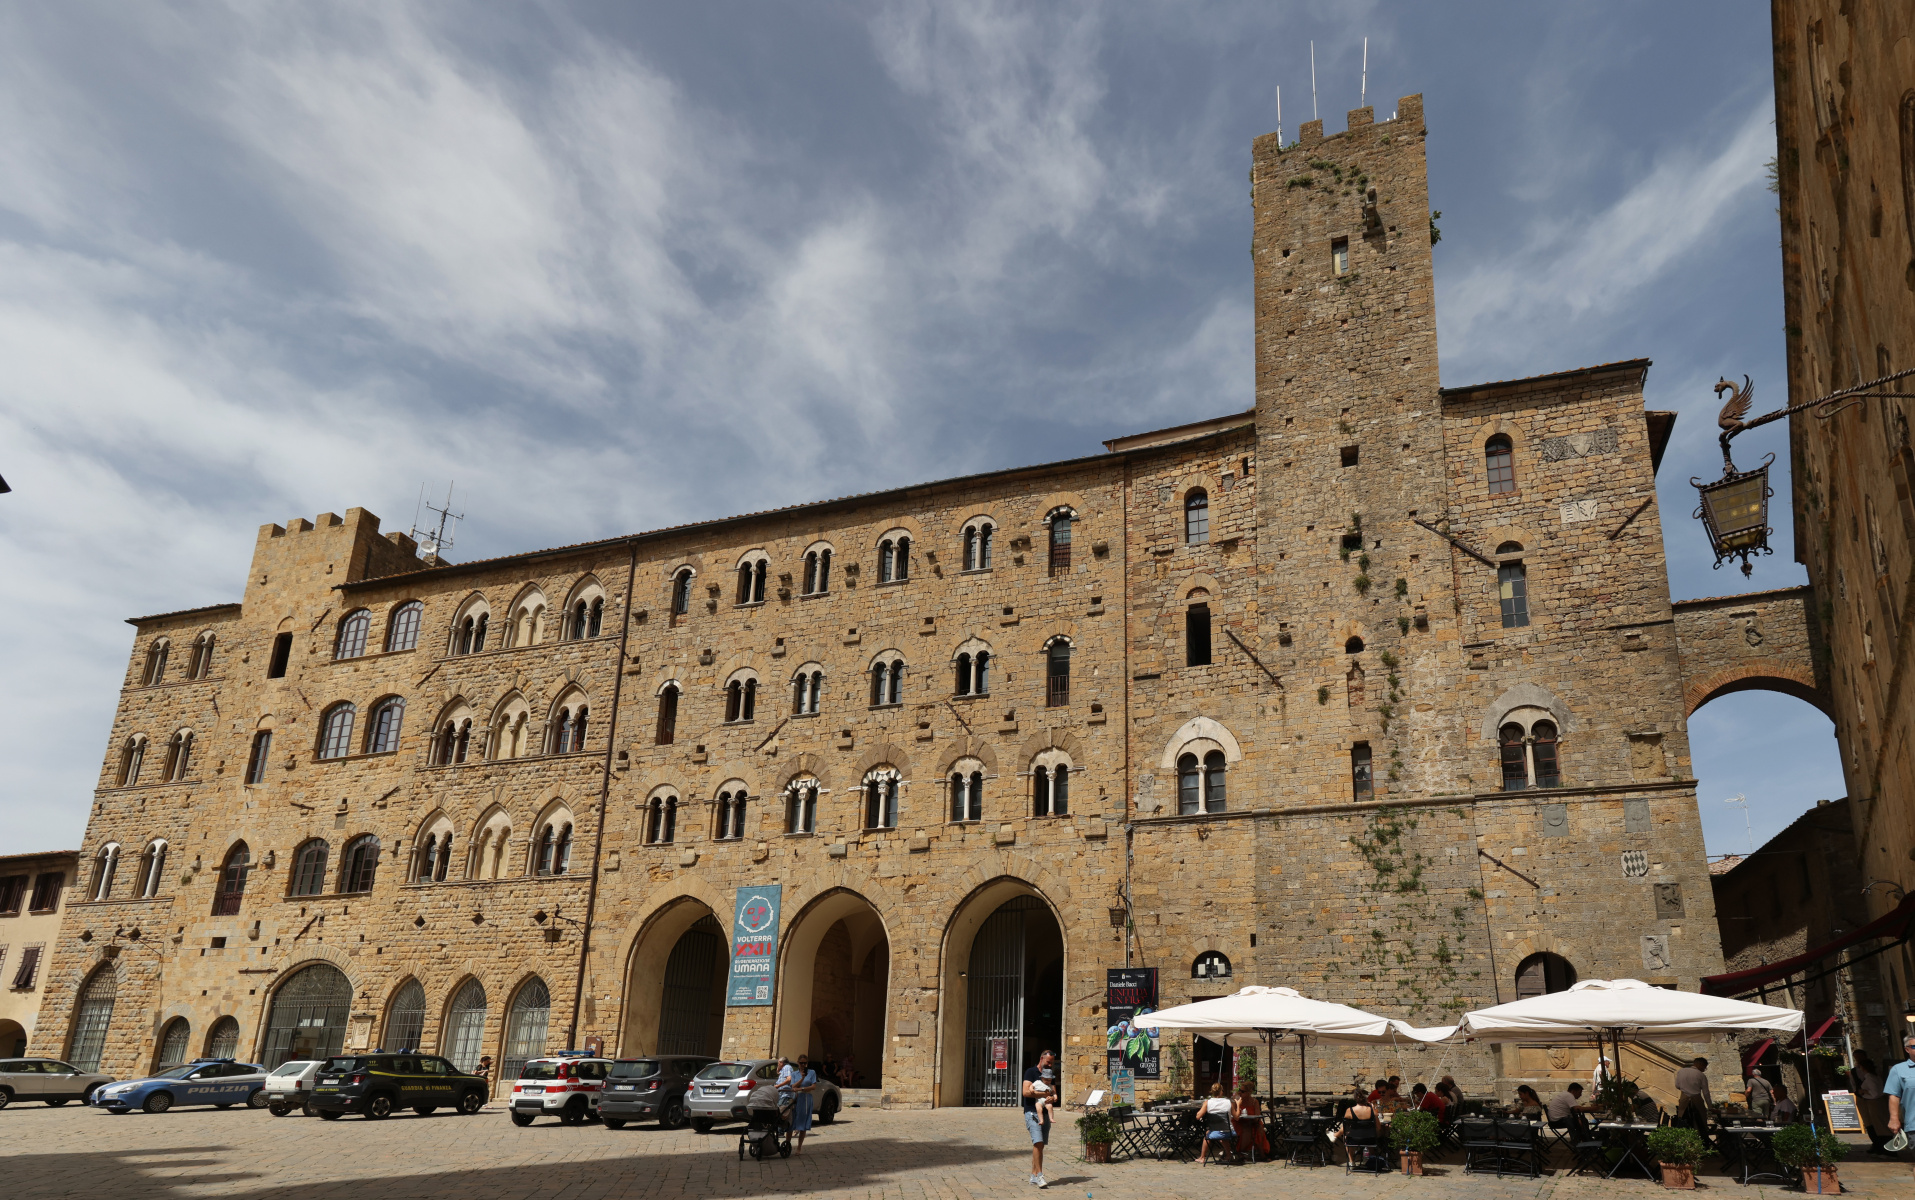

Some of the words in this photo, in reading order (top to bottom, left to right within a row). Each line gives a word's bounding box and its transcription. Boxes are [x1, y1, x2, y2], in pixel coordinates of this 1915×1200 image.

[736, 942, 771, 956] XXII
[734, 964, 770, 972] UMANA
[188, 1085, 249, 1094] POLIZIA
